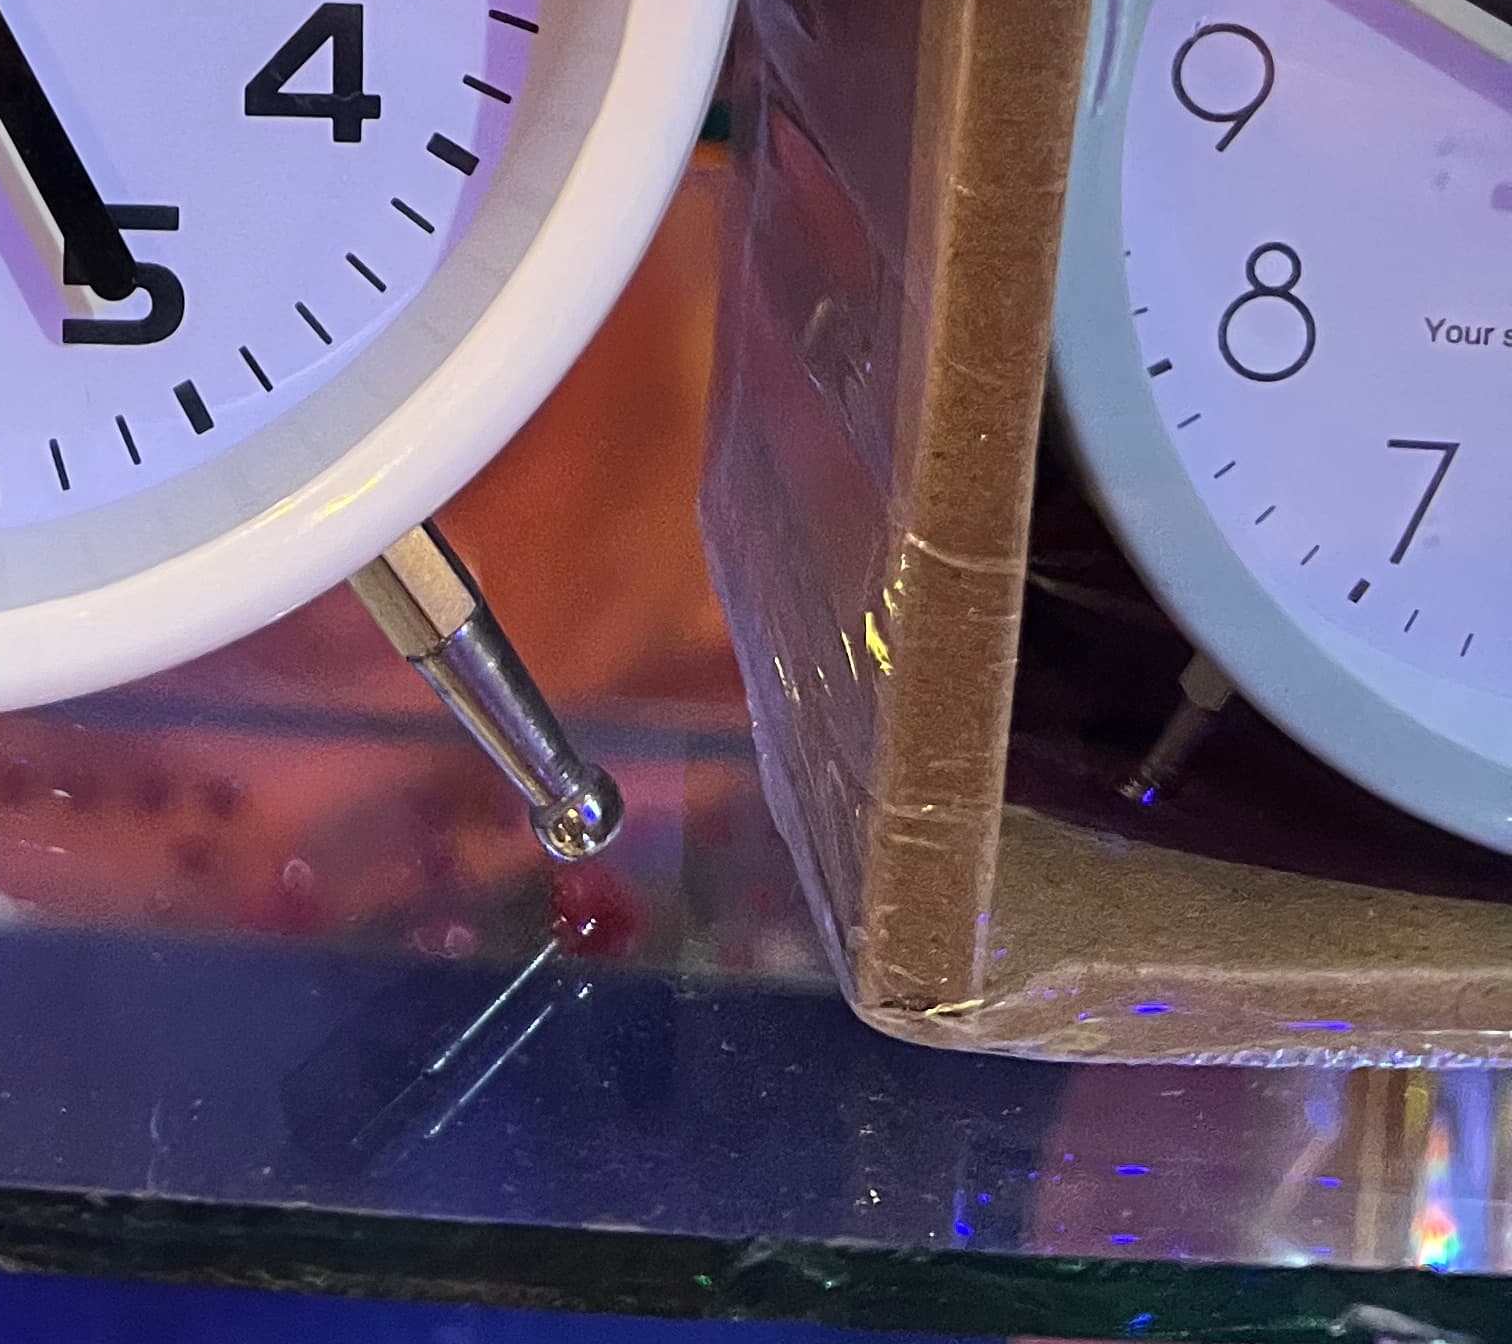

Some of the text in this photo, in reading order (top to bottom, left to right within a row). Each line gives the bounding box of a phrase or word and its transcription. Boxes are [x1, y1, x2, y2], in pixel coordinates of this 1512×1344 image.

[244, 2, 382, 144] 4
[1171, 23, 1275, 152] 9
[63, 204, 187, 346] 5
[1218, 241, 1316, 382] 8
[1424, 316, 1496, 346] Your
[1387, 439, 1461, 564] 7
